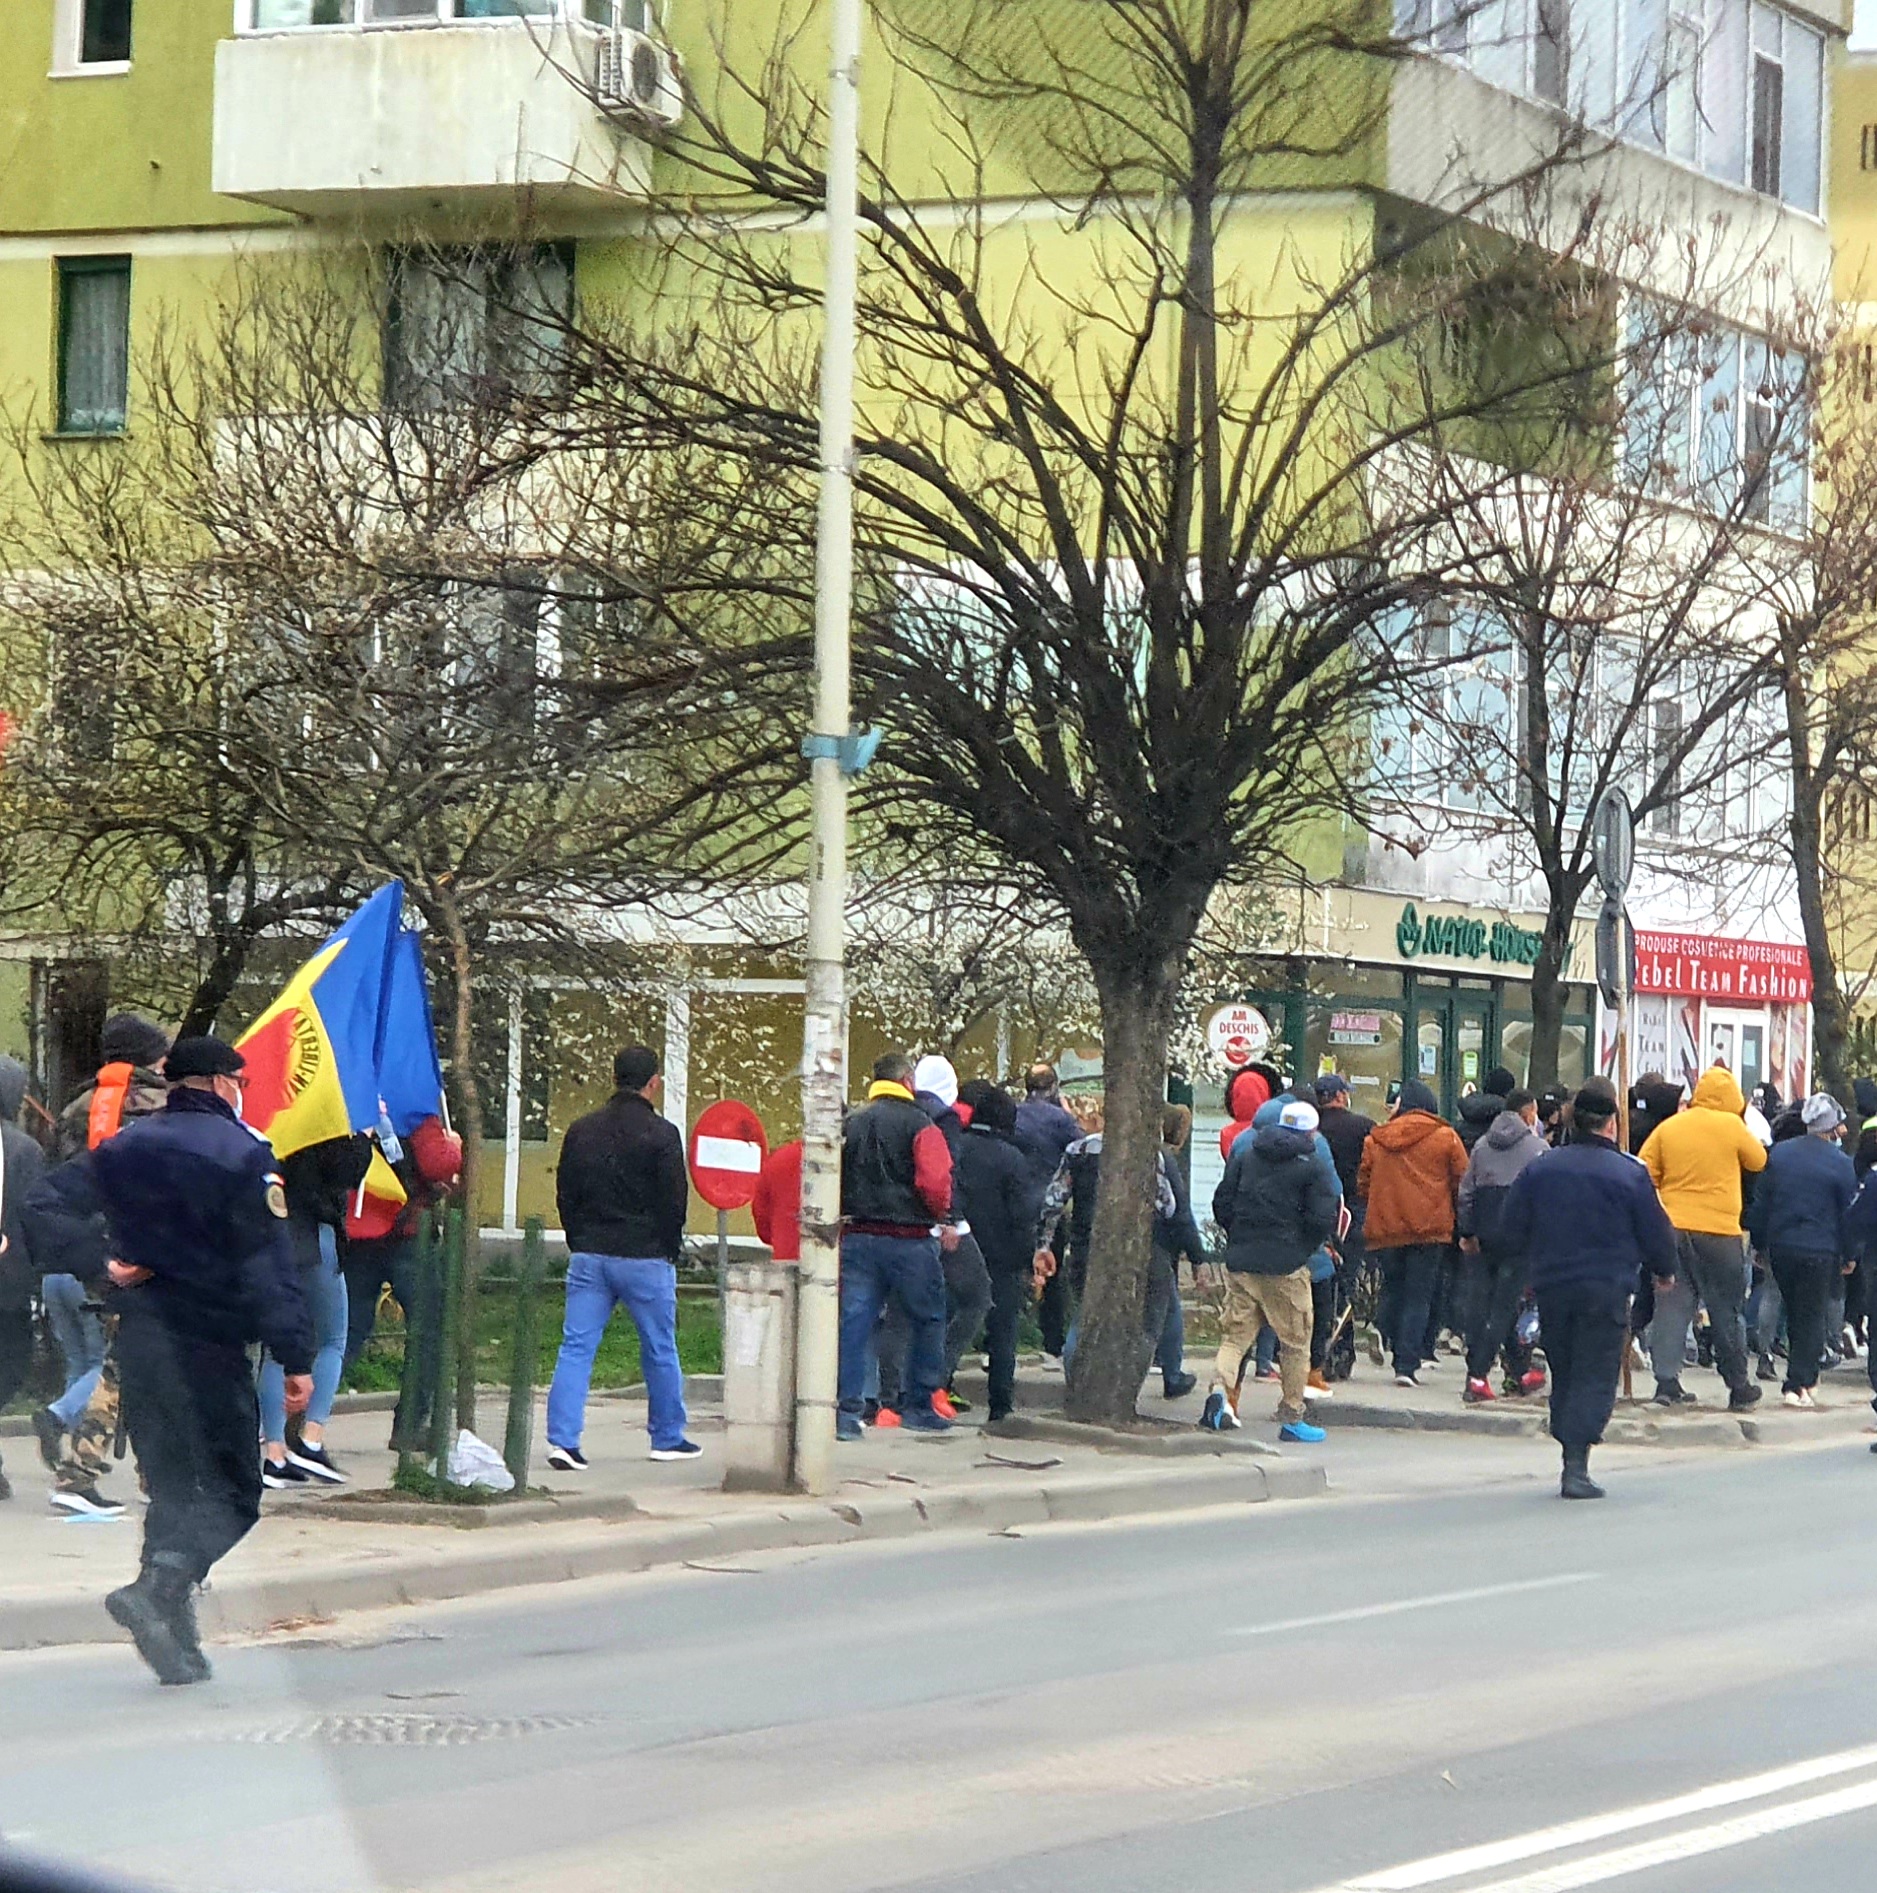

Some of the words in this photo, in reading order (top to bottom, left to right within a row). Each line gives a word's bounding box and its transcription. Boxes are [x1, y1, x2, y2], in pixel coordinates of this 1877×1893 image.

[1735, 944, 1803, 967] PROFESIONALE
[1231, 1010, 1247, 1021] AM
[1219, 1022, 1259, 1035] DESCHIS
